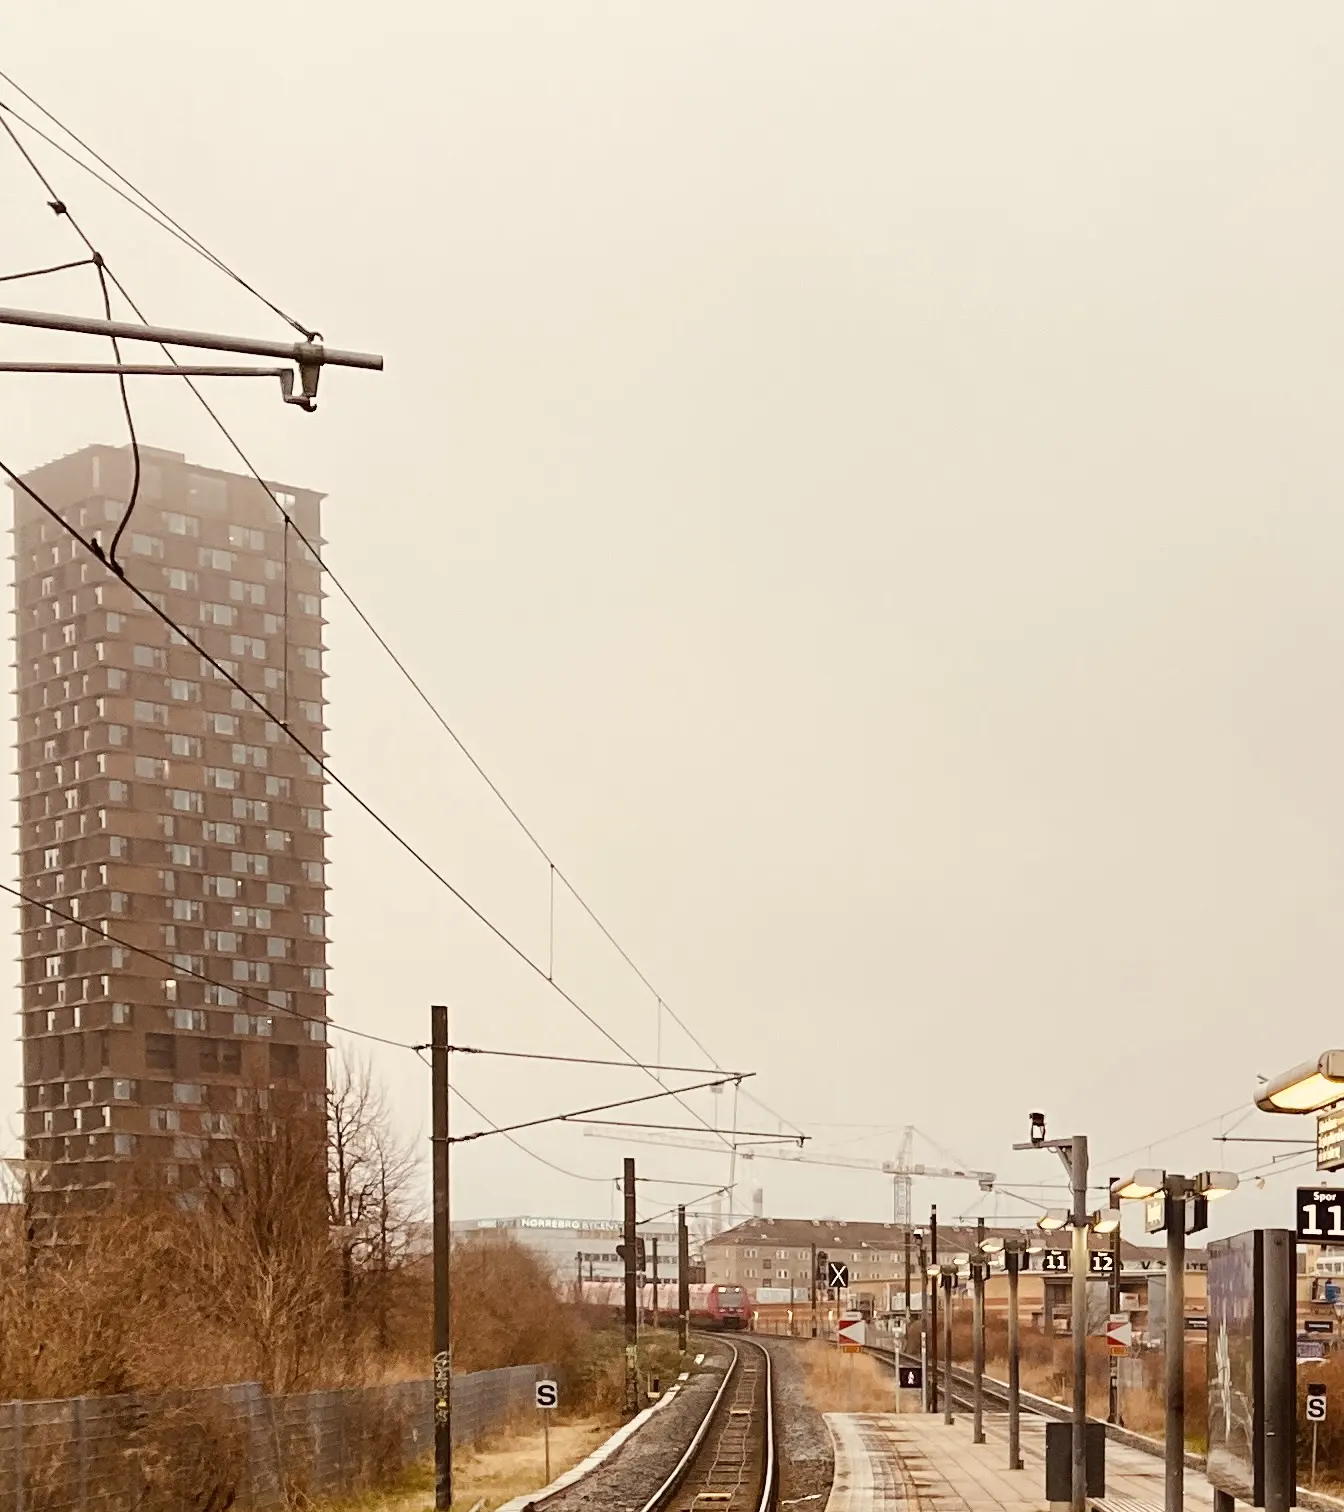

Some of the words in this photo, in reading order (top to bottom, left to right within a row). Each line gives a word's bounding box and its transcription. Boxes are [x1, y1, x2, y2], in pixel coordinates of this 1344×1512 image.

[1313, 1191, 1337, 1202] Spor
[1046, 1255, 1067, 1270] 11
[1092, 1256, 1113, 1271] 12
[537, 1384, 556, 1406] S
[1308, 1398, 1325, 1418] S
